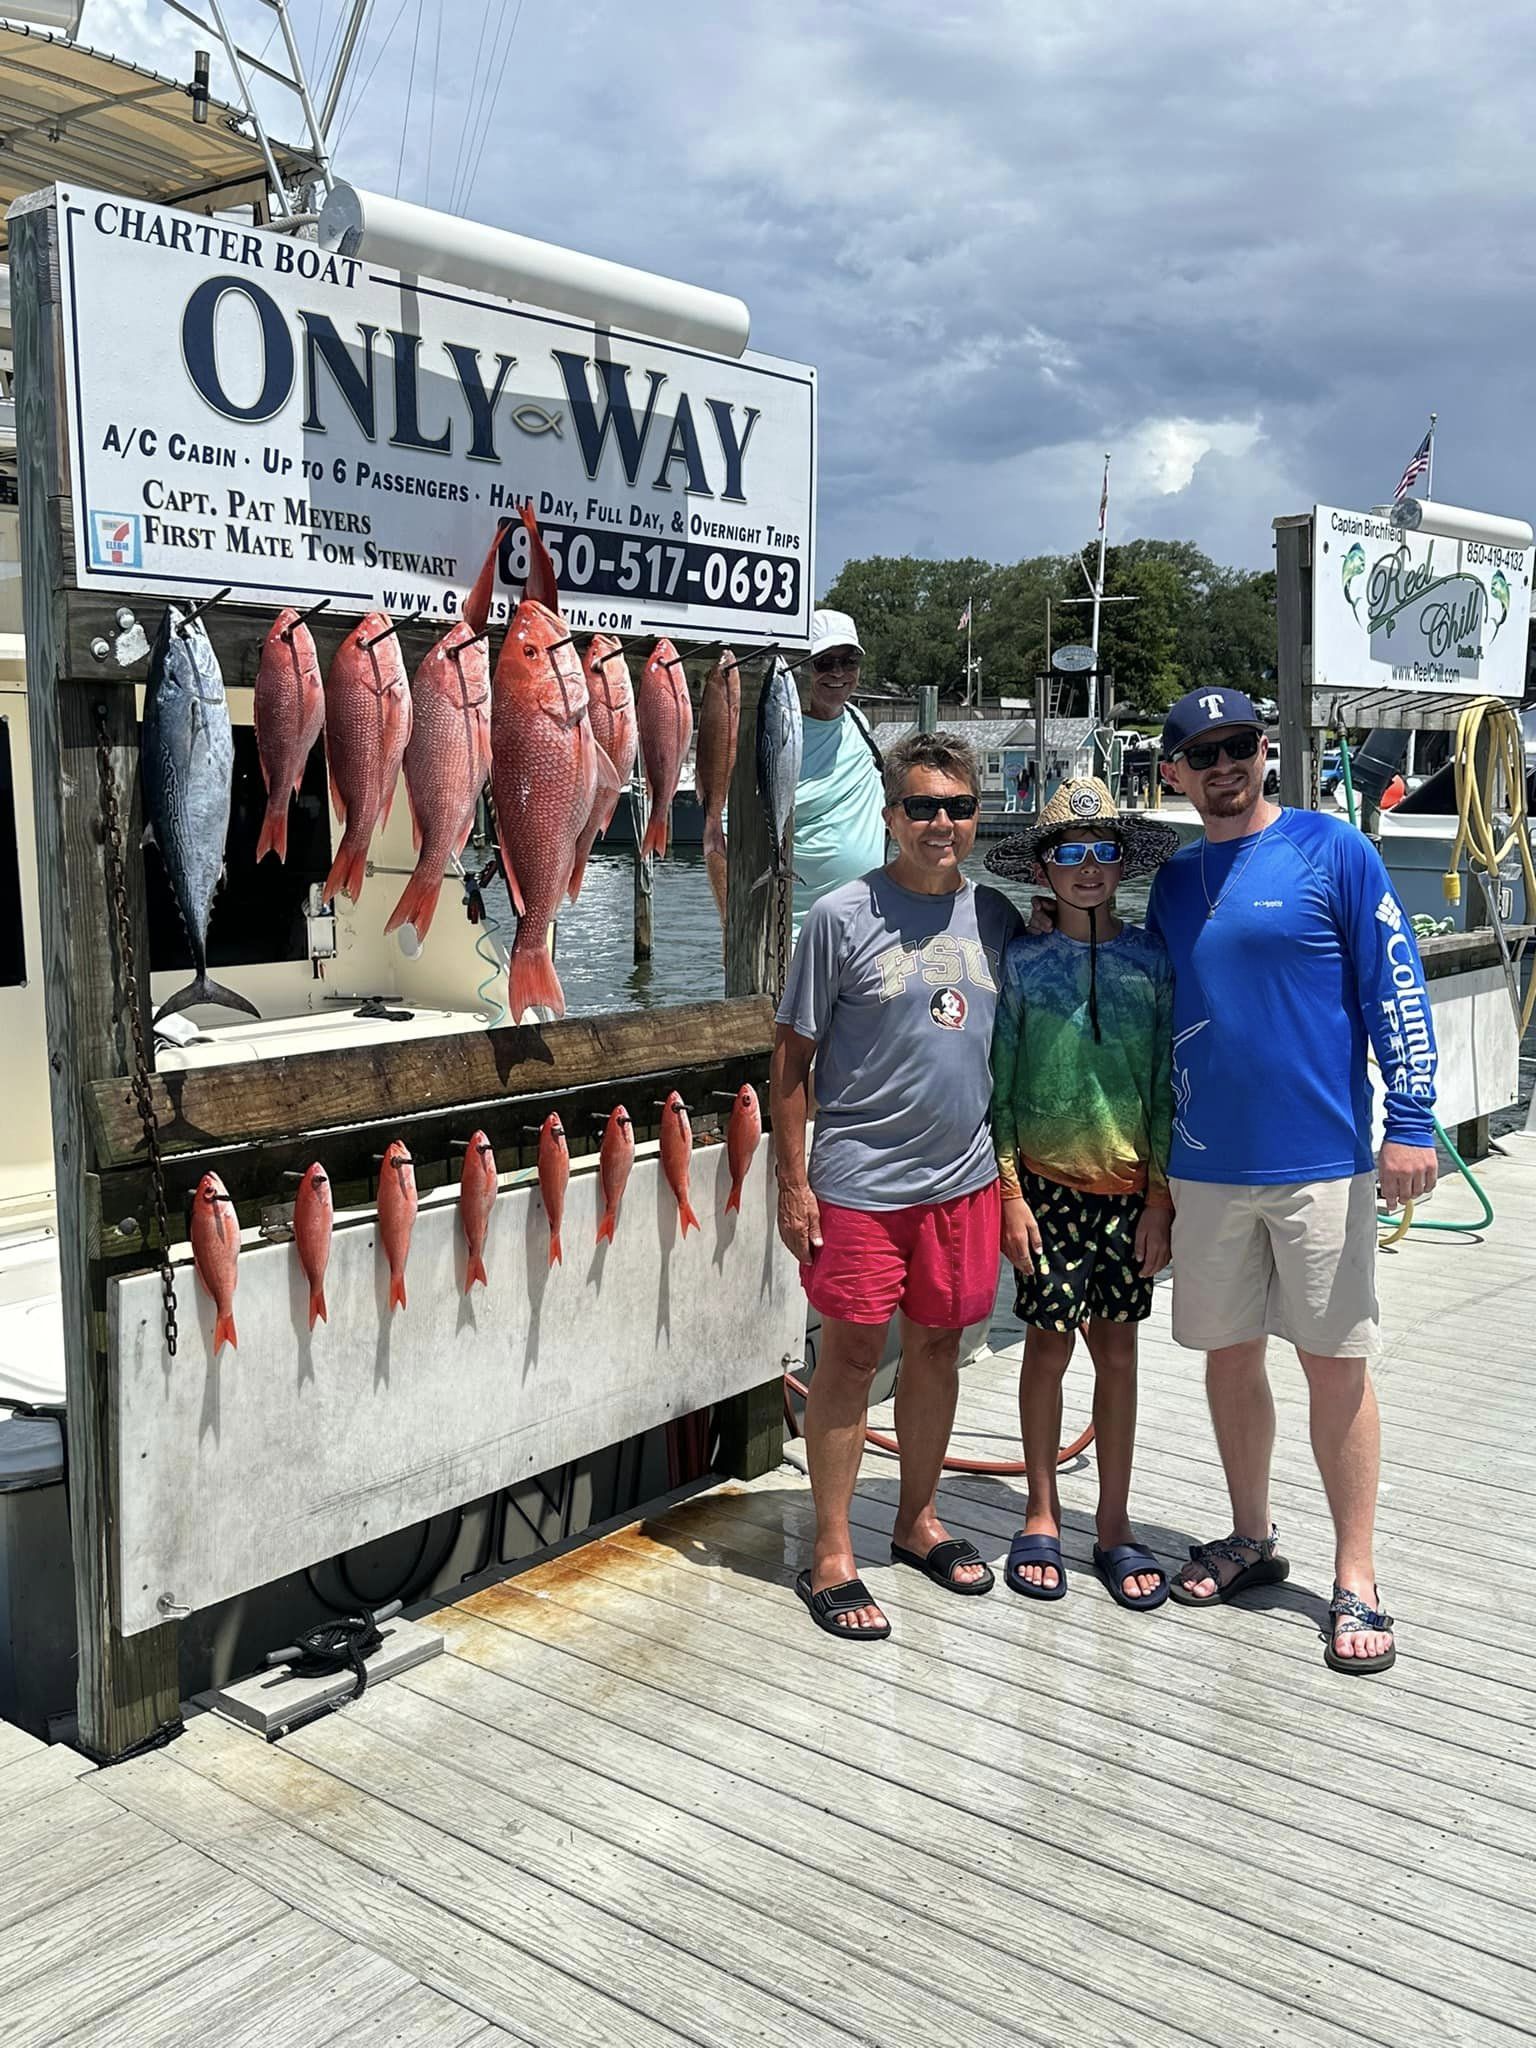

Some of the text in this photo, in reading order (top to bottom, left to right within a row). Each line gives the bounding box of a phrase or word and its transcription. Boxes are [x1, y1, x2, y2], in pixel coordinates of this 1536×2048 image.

[94, 203, 362, 288] CHARTER BOAT
[181, 275, 760, 503] ONLY WAY
[102, 424, 157, 458] A/C
[168, 433, 236, 469] CABIN
[263, 447, 293, 476] UP
[303, 460, 323, 480] TO
[332, 458, 347, 484] 6
[356, 462, 469, 503] PASSENGERS
[540, 491, 577, 523] DAY,
[586, 498, 622, 524] FULL
[629, 504, 664, 535] DAY,
[671, 511, 684, 534] &
[690, 514, 762, 544] OVERNIGHT
[767, 525, 800, 550] TRIPS
[142, 479, 371, 535] CAPT. PAT MEYERS
[142, 515, 457, 577] FIRST MATE TOM STEWART
[1331, 512, 1402, 542] Captain Birchfield
[1466, 543, 1524, 571] 850-419-4132
[1366, 539, 1434, 619] Reel
[1420, 587, 1479, 657] Chill
[1198, 694, 1224, 720] T
[874, 934, 1000, 1003] FSU
[1387, 933, 1438, 1098] Columbia
